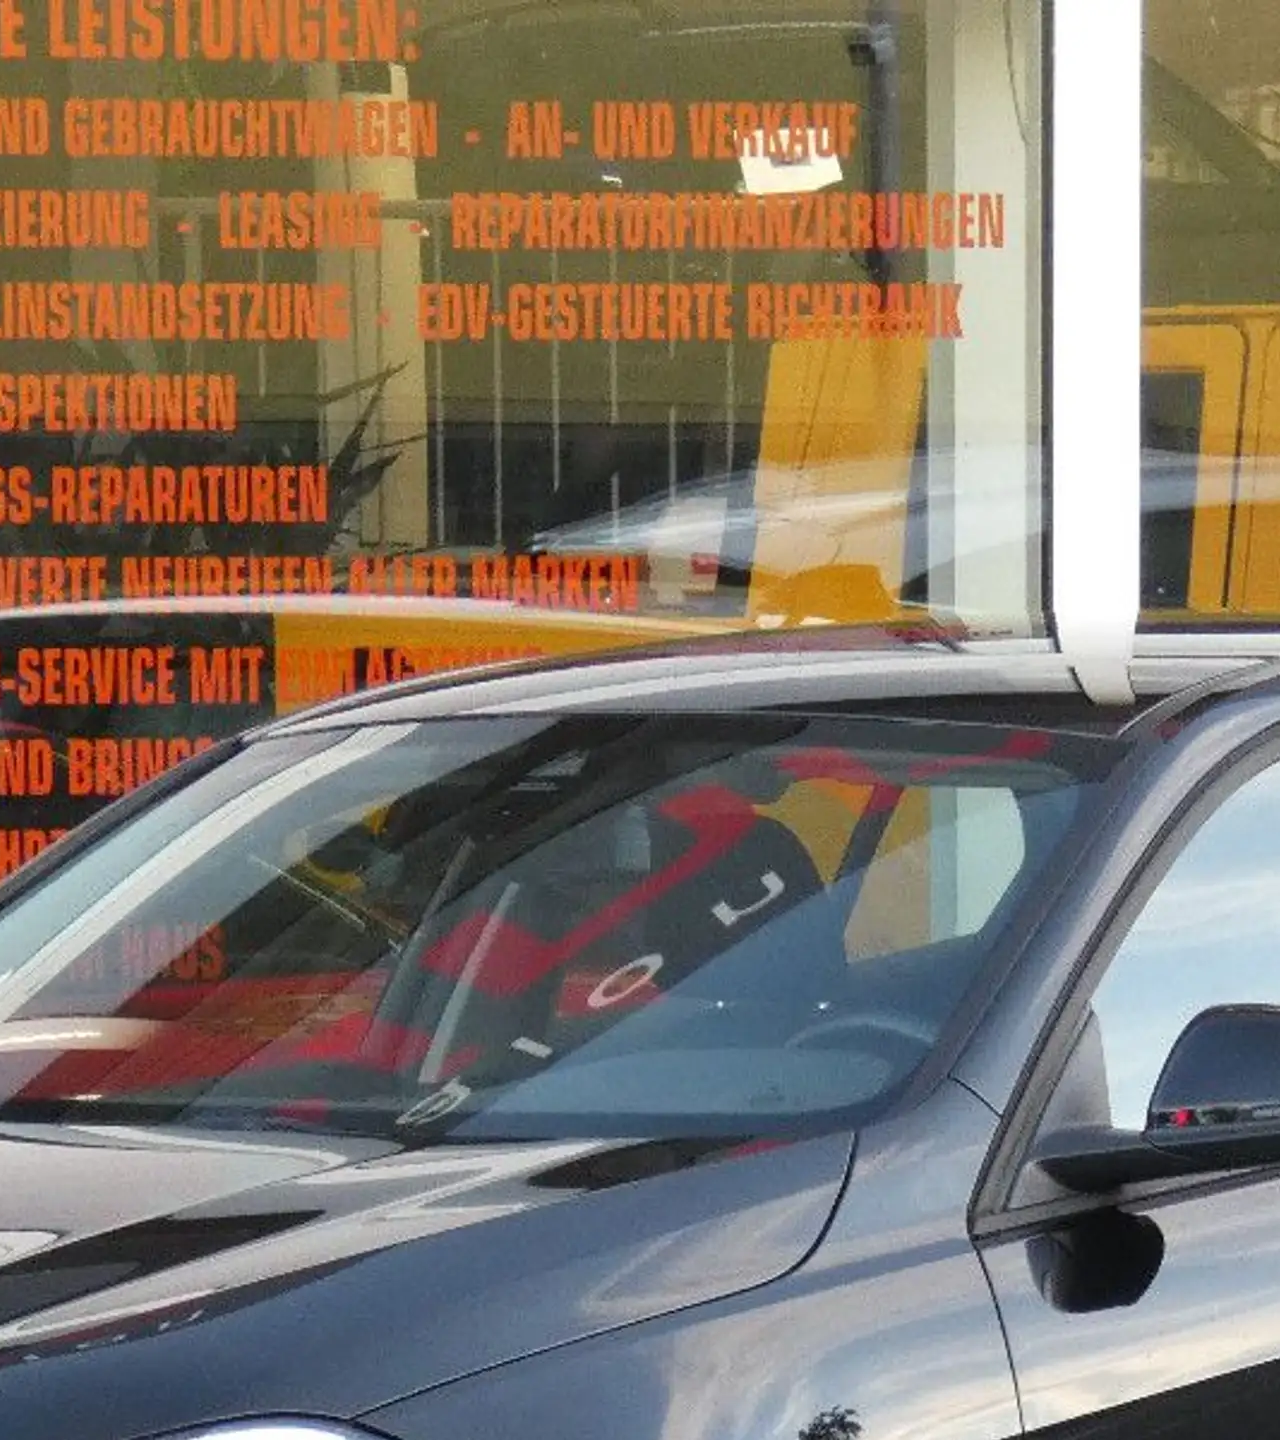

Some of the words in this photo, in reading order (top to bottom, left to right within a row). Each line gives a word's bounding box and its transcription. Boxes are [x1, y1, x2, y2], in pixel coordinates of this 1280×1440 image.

[49, 0, 420, 62] LEISTUNGEN:
[65, 100, 437, 157] GEBRAUCHTWAGEN
[507, 102, 578, 157] AN-
[593, 103, 675, 157] UND
[689, 103, 858, 157] VERKAUF
[218, 191, 382, 249] LEASING
[451, 192, 1005, 250] REPARATURFINANZIERUNGEN
[417, 283, 733, 341] EDV-GESTEUERTE
[746, 283, 963, 342] RICHTBANK
[120, 555, 333, 599] NEUREIFEN
[470, 554, 640, 611] MARKEN
[189, 646, 267, 706] MIT
